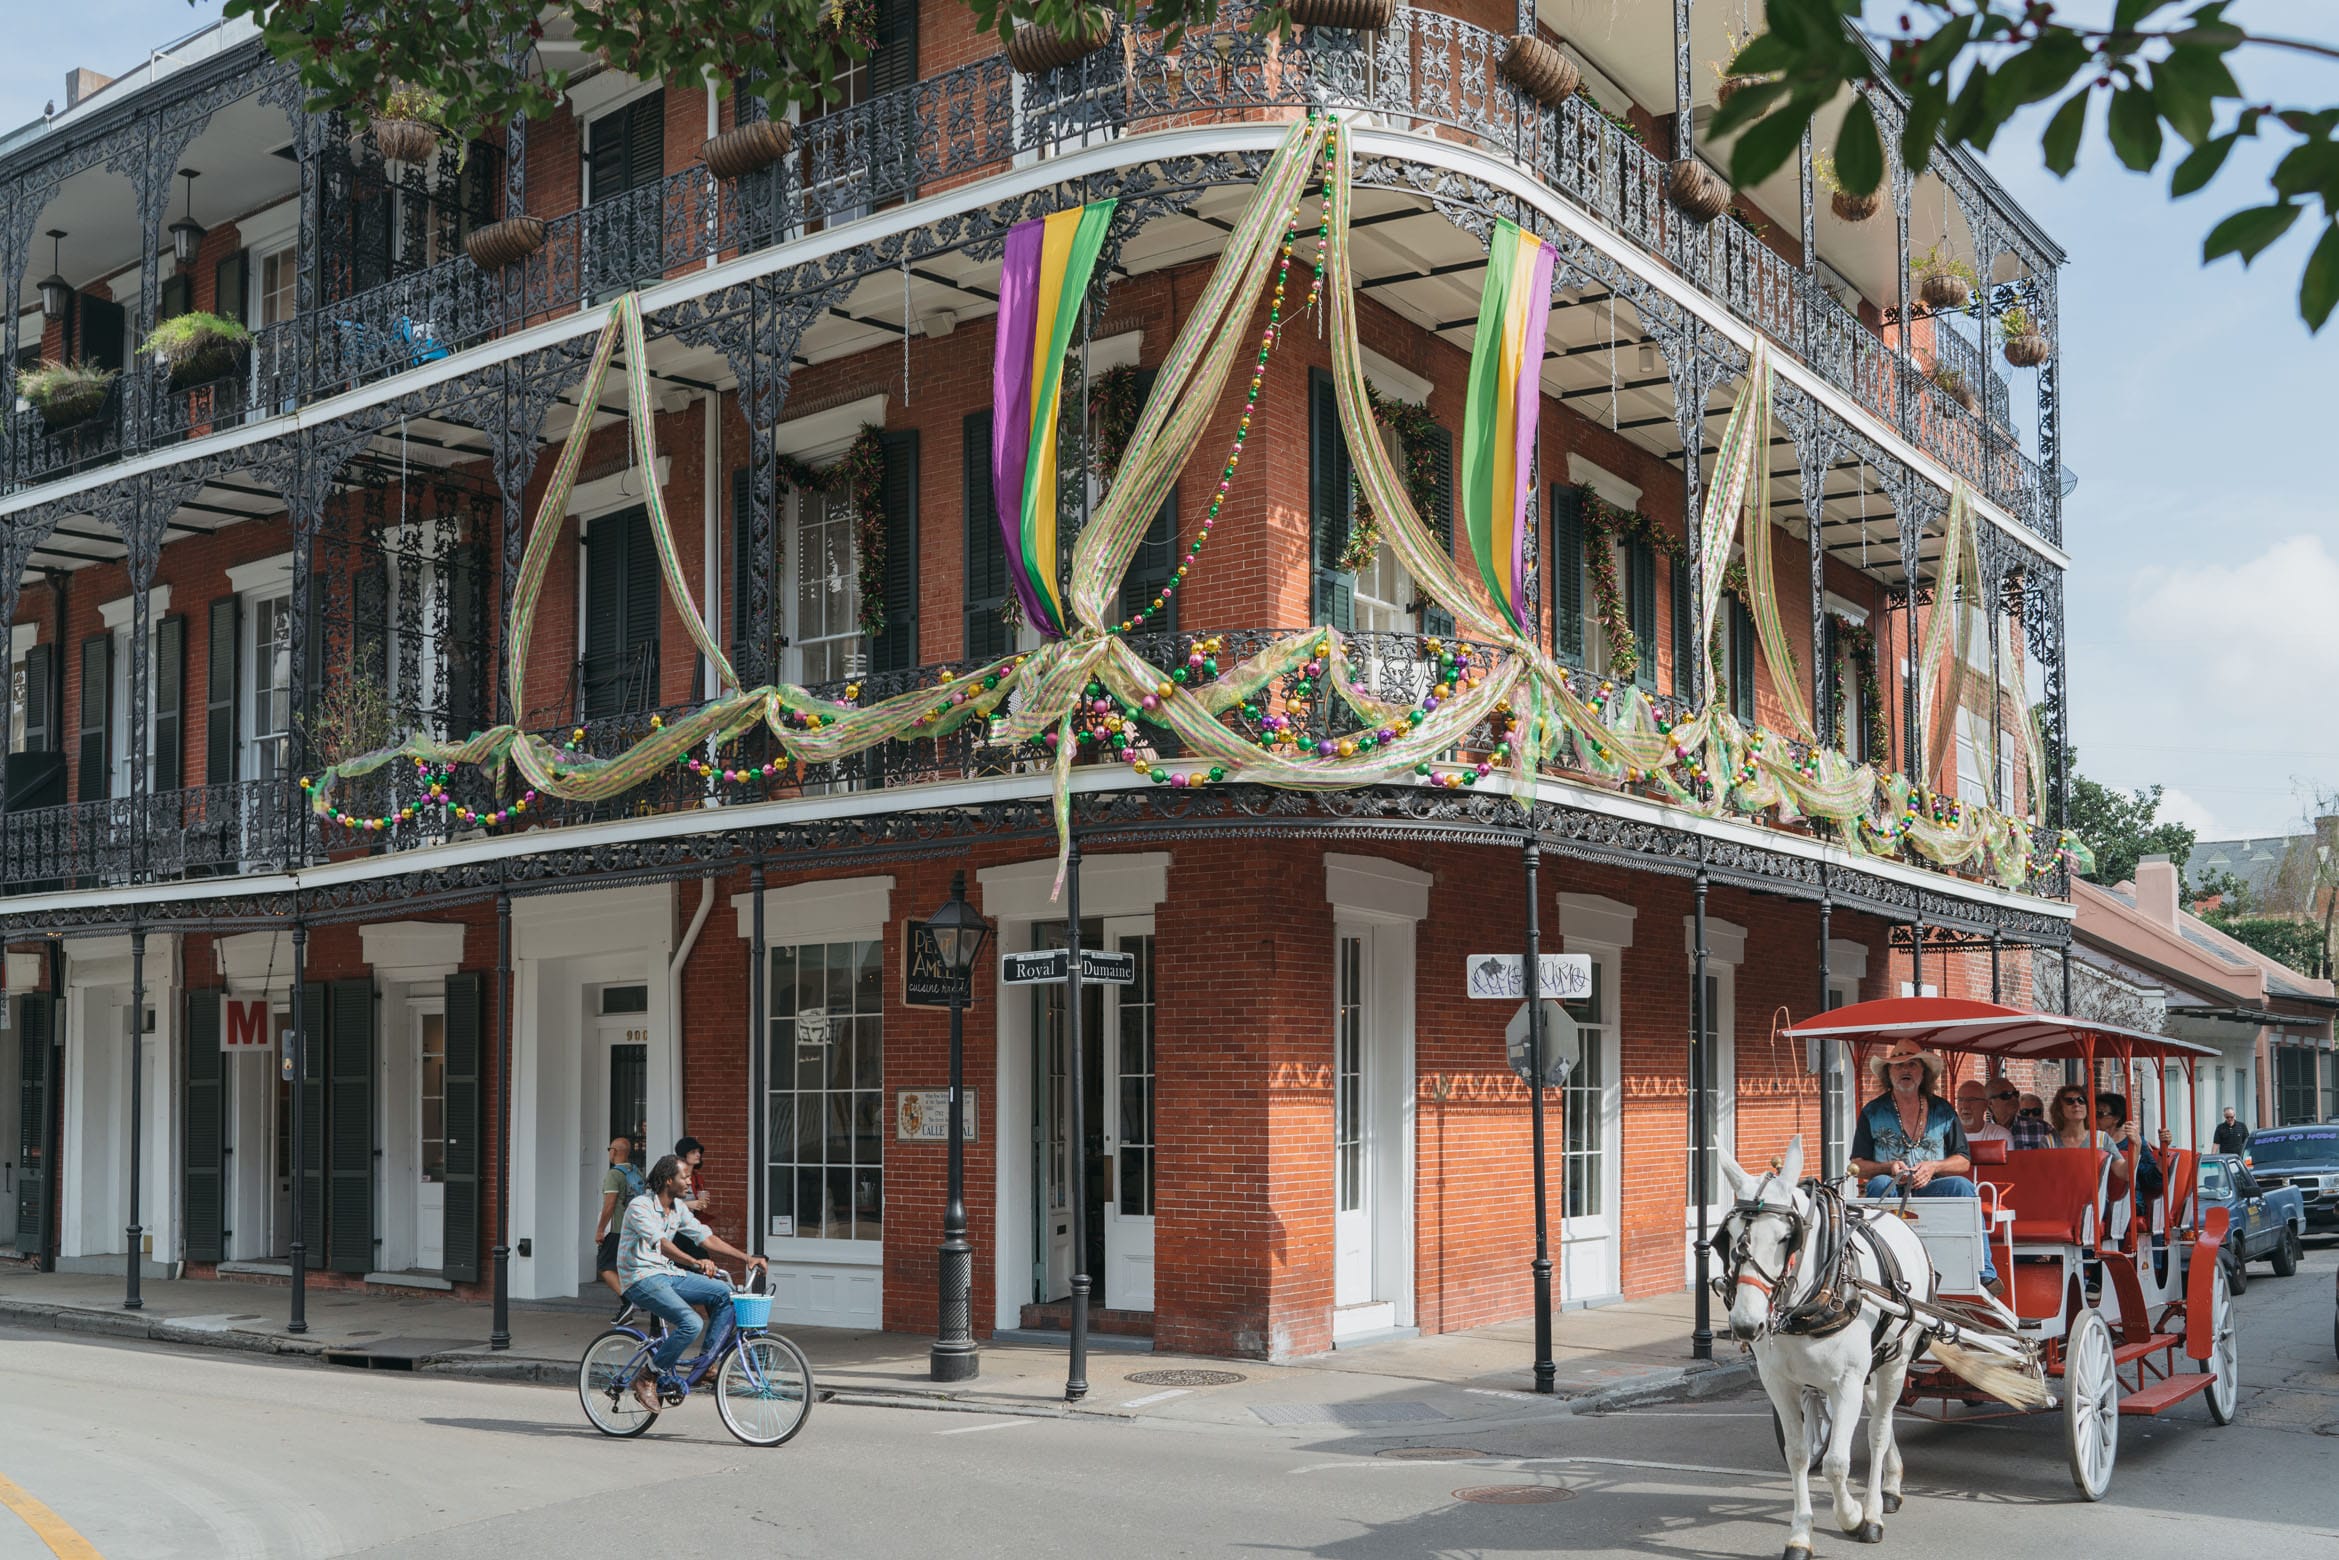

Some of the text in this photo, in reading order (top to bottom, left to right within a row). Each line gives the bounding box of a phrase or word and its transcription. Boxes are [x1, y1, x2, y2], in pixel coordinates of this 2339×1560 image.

[1016, 960, 1055, 978] Royal
[1084, 960, 1132, 978] Dumaine
[227, 1001, 267, 1045] M
[922, 1124, 945, 1137] CALLE
